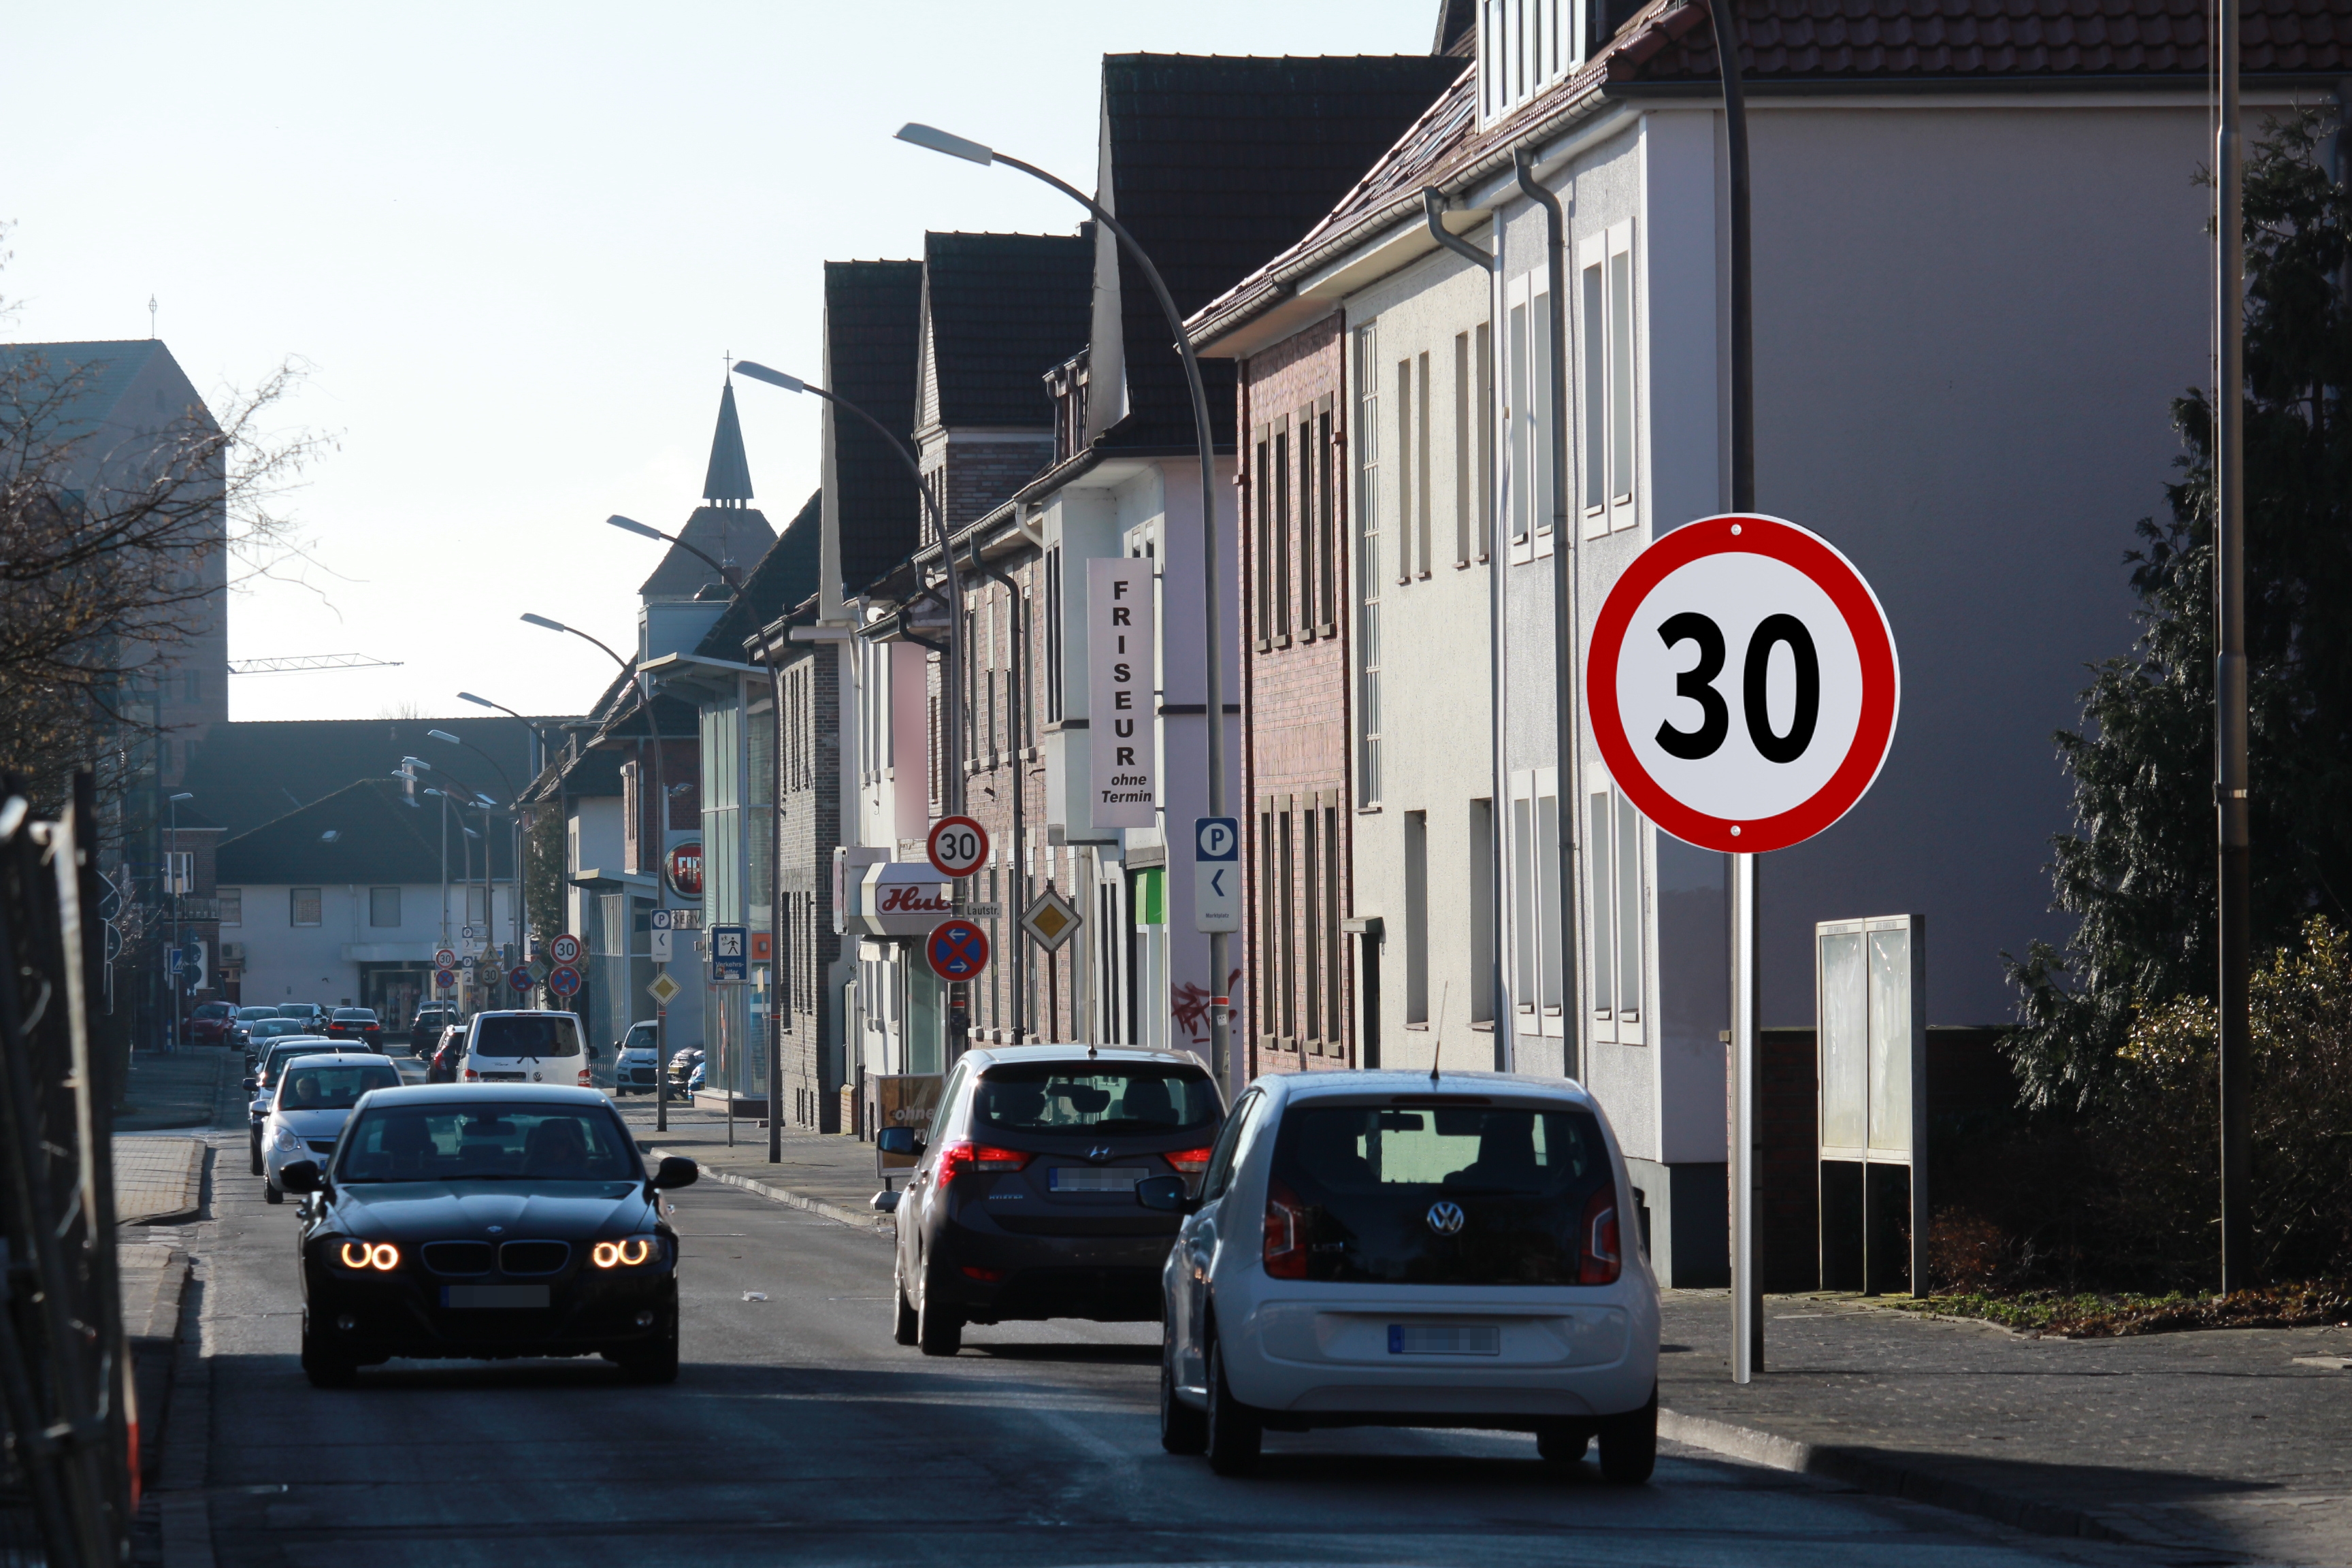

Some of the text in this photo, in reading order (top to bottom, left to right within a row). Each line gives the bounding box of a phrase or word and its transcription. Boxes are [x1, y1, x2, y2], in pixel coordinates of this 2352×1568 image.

[1113, 581, 1136, 766] FRISEUR
[1655, 611, 1820, 764] 30
[1111, 774, 1147, 786] ohne
[1101, 790, 1152, 803] Termin
[1211, 828, 1224, 851] P
[941, 832, 976, 861] 30
[967, 905, 999, 915] Lautstr.
[659, 915, 665, 925] P
[557, 943, 574, 956] 30
[440, 955, 451, 964] 30
[484, 970, 496, 981] 30
[896, 1106, 934, 1121] ohne
